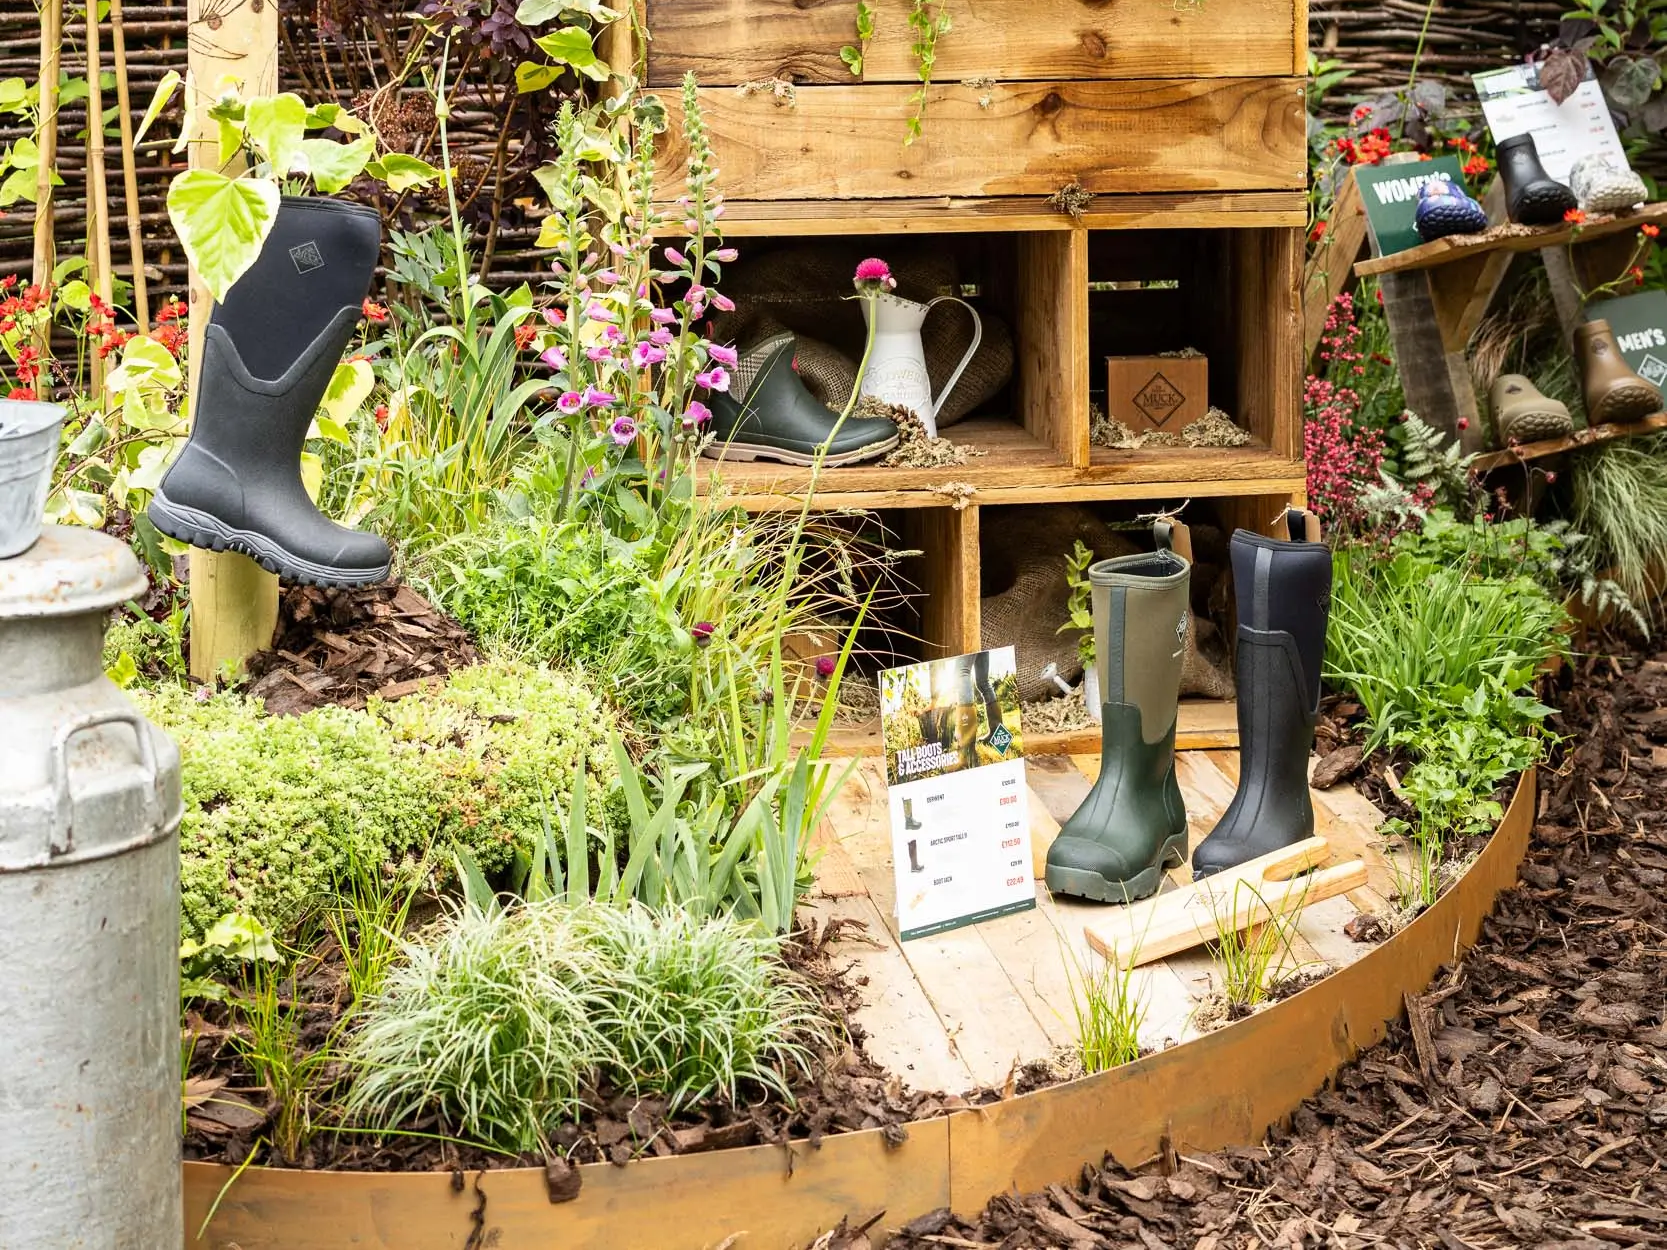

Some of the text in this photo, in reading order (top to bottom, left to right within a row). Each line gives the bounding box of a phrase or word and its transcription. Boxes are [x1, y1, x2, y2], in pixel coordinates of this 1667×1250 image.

[1616, 328, 1666, 353] MEN'S
[1143, 393, 1177, 404] MUCK
[896, 741, 943, 763] TALL BOOTS
[906, 750, 959, 775] ACCESSORIES
